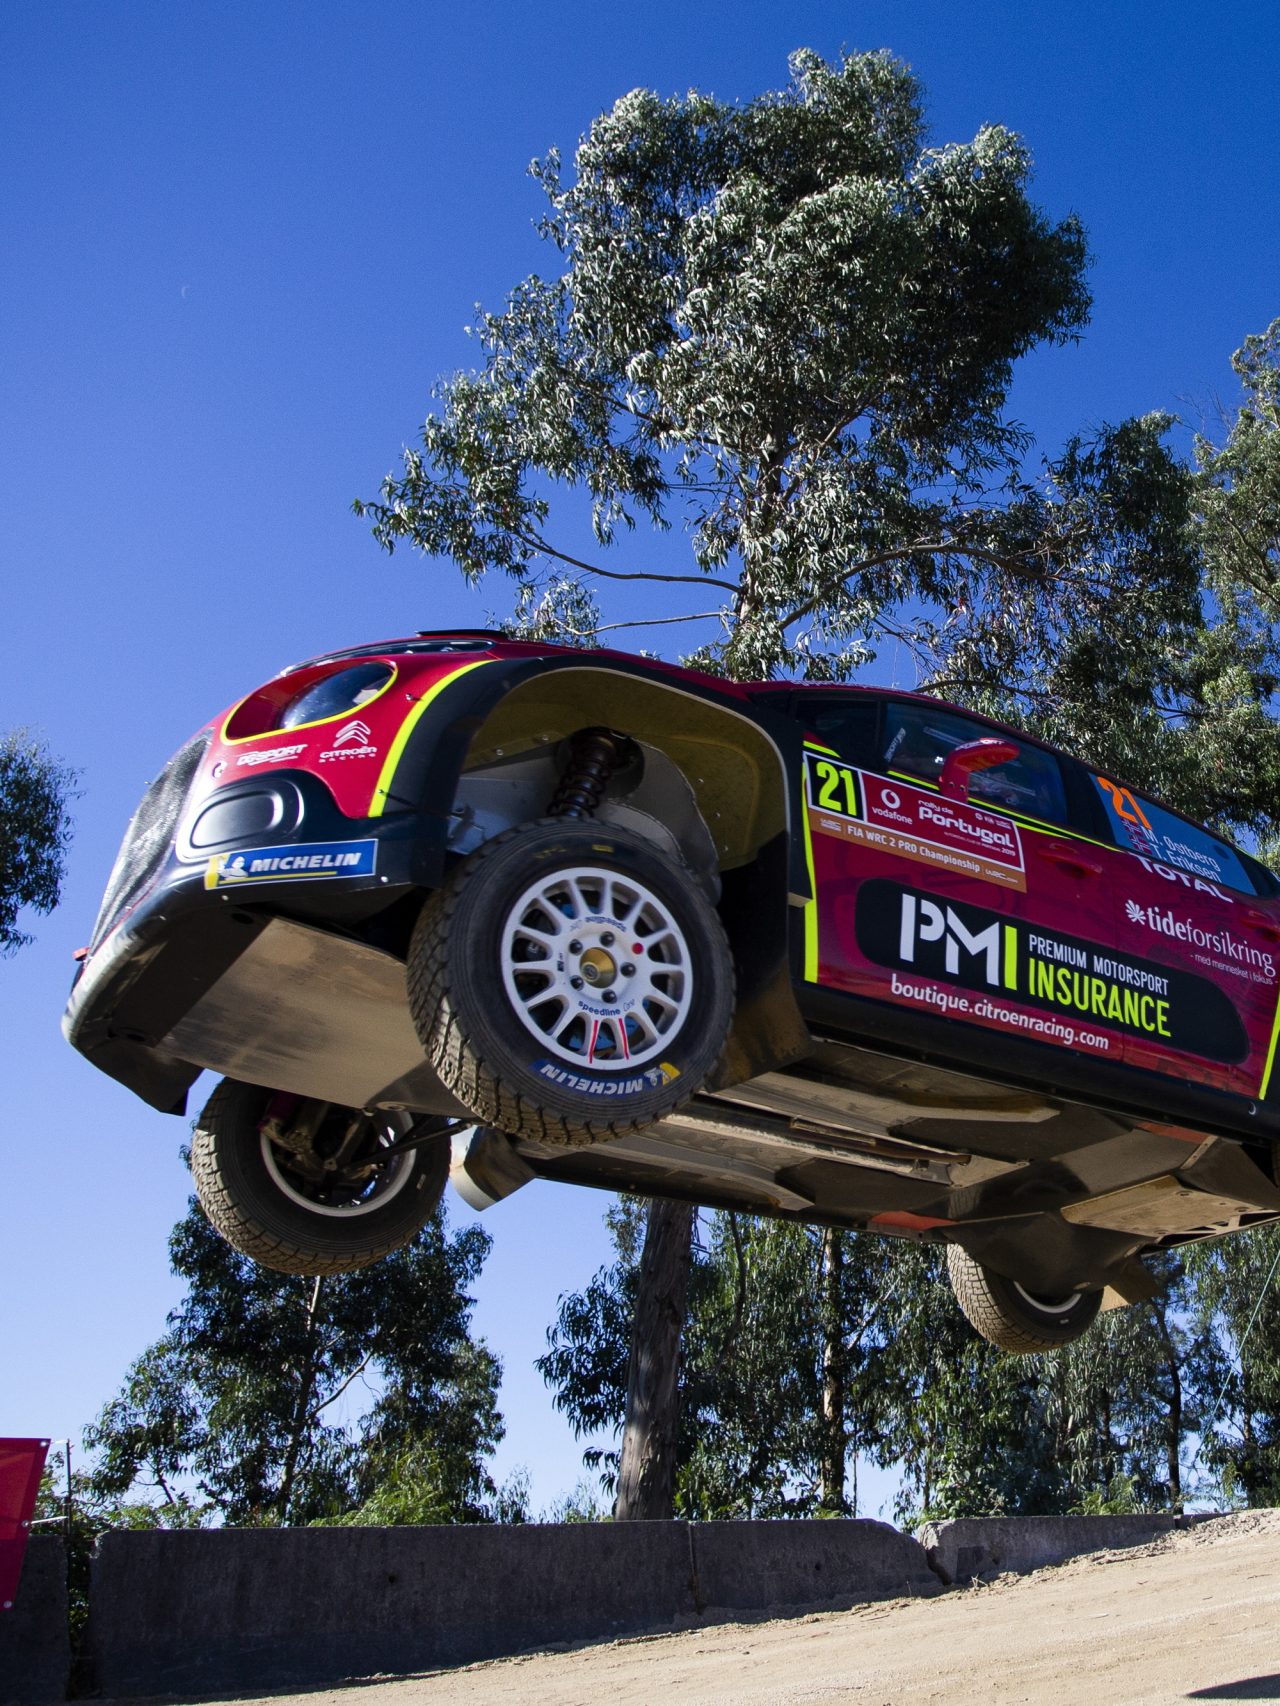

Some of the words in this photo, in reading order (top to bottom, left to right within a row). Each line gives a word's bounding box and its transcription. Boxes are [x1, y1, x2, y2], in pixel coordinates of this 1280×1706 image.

[815, 761, 857, 817] 21
[918, 800, 941, 813] rally
[941, 806, 954, 815] de
[1096, 776, 1153, 830] 21
[872, 806, 913, 825] vodafone
[918, 806, 1015, 848] Portugal
[249, 852, 362, 873] MICHELIN
[847, 825, 864, 839] FIA
[866, 829, 888, 845] WRC
[889, 836, 896, 847] 2
[898, 840, 917, 855] PRO
[919, 846, 981, 873] Championship
[1163, 835, 1221, 872] Østberg
[1166, 850, 1222, 883] Eriksen
[1127, 851, 1234, 904] TOTAL
[1029, 933, 1087, 969] PREMIUM
[1093, 955, 1169, 996] MOTORSPORT
[1146, 906, 1277, 978] tideforsikring
[577, 1000, 621, 1016] speedline
[891, 973, 1109, 1050] boutique.citroenracing.com
[1028, 957, 1172, 1037] INSURANCE
[540, 1063, 644, 1095] MICHELIN
